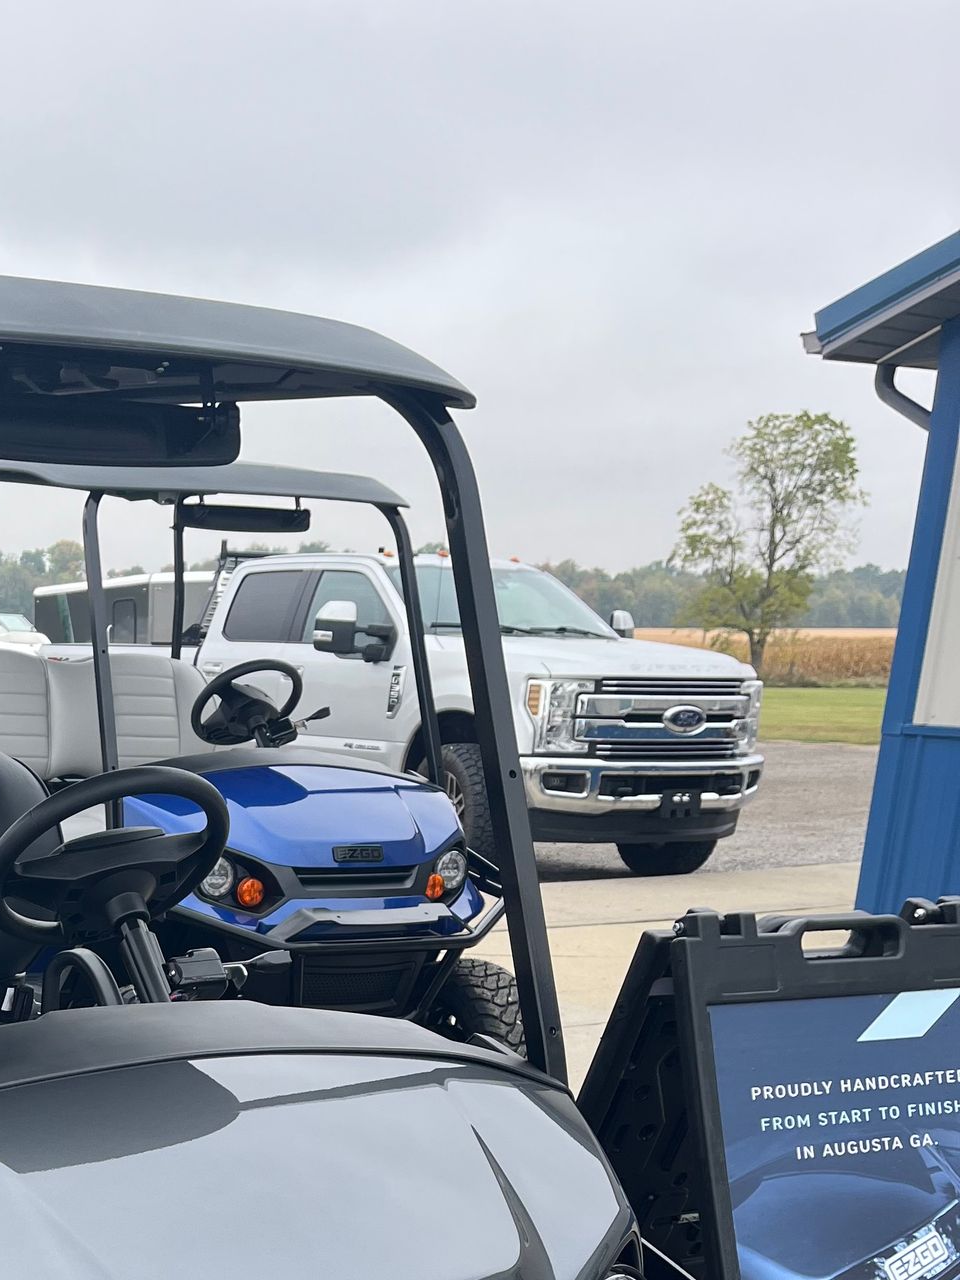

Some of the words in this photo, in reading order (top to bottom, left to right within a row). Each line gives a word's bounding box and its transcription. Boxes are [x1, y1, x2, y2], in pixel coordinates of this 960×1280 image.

[336, 848, 381, 859] EZGO
[750, 1080, 833, 1101] PROUDLY
[760, 1113, 811, 1132] FROM
[818, 1108, 872, 1126] START
[878, 1106, 900, 1120] TO
[796, 1145, 815, 1160] IN
[822, 1136, 903, 1158] AUGUSTA
[909, 1133, 939, 1148] GA.
